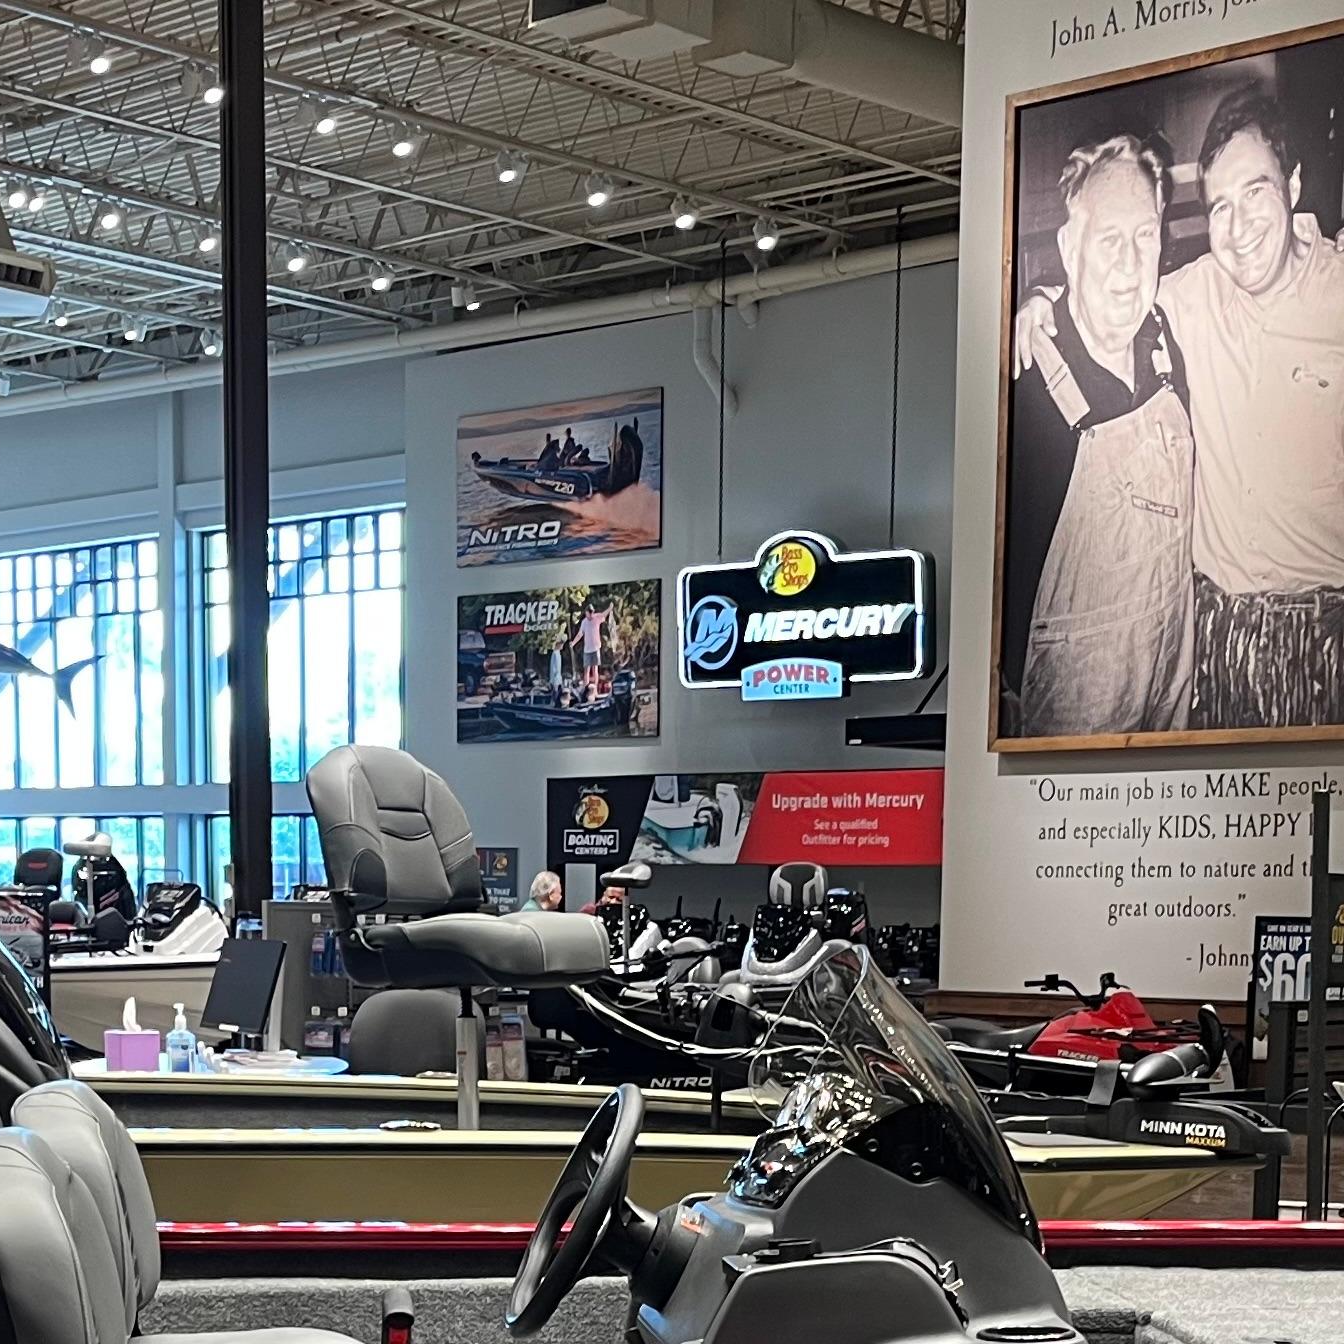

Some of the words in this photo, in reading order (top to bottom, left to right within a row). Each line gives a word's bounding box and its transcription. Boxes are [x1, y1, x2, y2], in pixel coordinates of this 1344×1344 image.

[1050, 19, 1095, 58] John
[1103, 8, 1126, 38] A.
[1134, 0, 1214, 30] Morris,
[484, 600, 560, 626] TRACKER
[743, 602, 916, 643] MERCURY
[752, 663, 831, 688] POWER
[773, 683, 810, 695] CENTER
[1079, 781, 1120, 800] main
[1126, 777, 1154, 807] job
[1161, 780, 1174, 799] is
[1181, 781, 1197, 799] to
[1204, 772, 1271, 798] MAKE
[772, 793, 828, 811] Upgrade
[832, 793, 862, 808] with
[865, 793, 925, 810] Mercury
[814, 818, 830, 830] See
[1038, 818, 1067, 840] and
[1073, 817, 1152, 848] especially
[1158, 813, 1216, 840] KIDS,
[1223, 812, 1302, 838] HAPPY
[568, 834, 615, 846] BOATING
[801, 833, 841, 846] Outfitter
[843, 833, 856, 845] for
[858, 833, 890, 848] pricing
[1036, 861, 1124, 888] connecting
[1131, 856, 1172, 878] them
[1180, 862, 1196, 878] to
[1203, 862, 1257, 878] nature
[1262, 854, 1295, 878] and
[1107, 902, 1149, 927] great
[1260, 935, 1287, 951] EARN
[1289, 935, 1303, 951] UP
[1056, 1049, 1100, 1063] TRACKER
[1140, 1119, 1182, 1135] MINN
[1184, 1121, 1227, 1138] KOTA
[1185, 1135, 1227, 1148] MAXXUM
